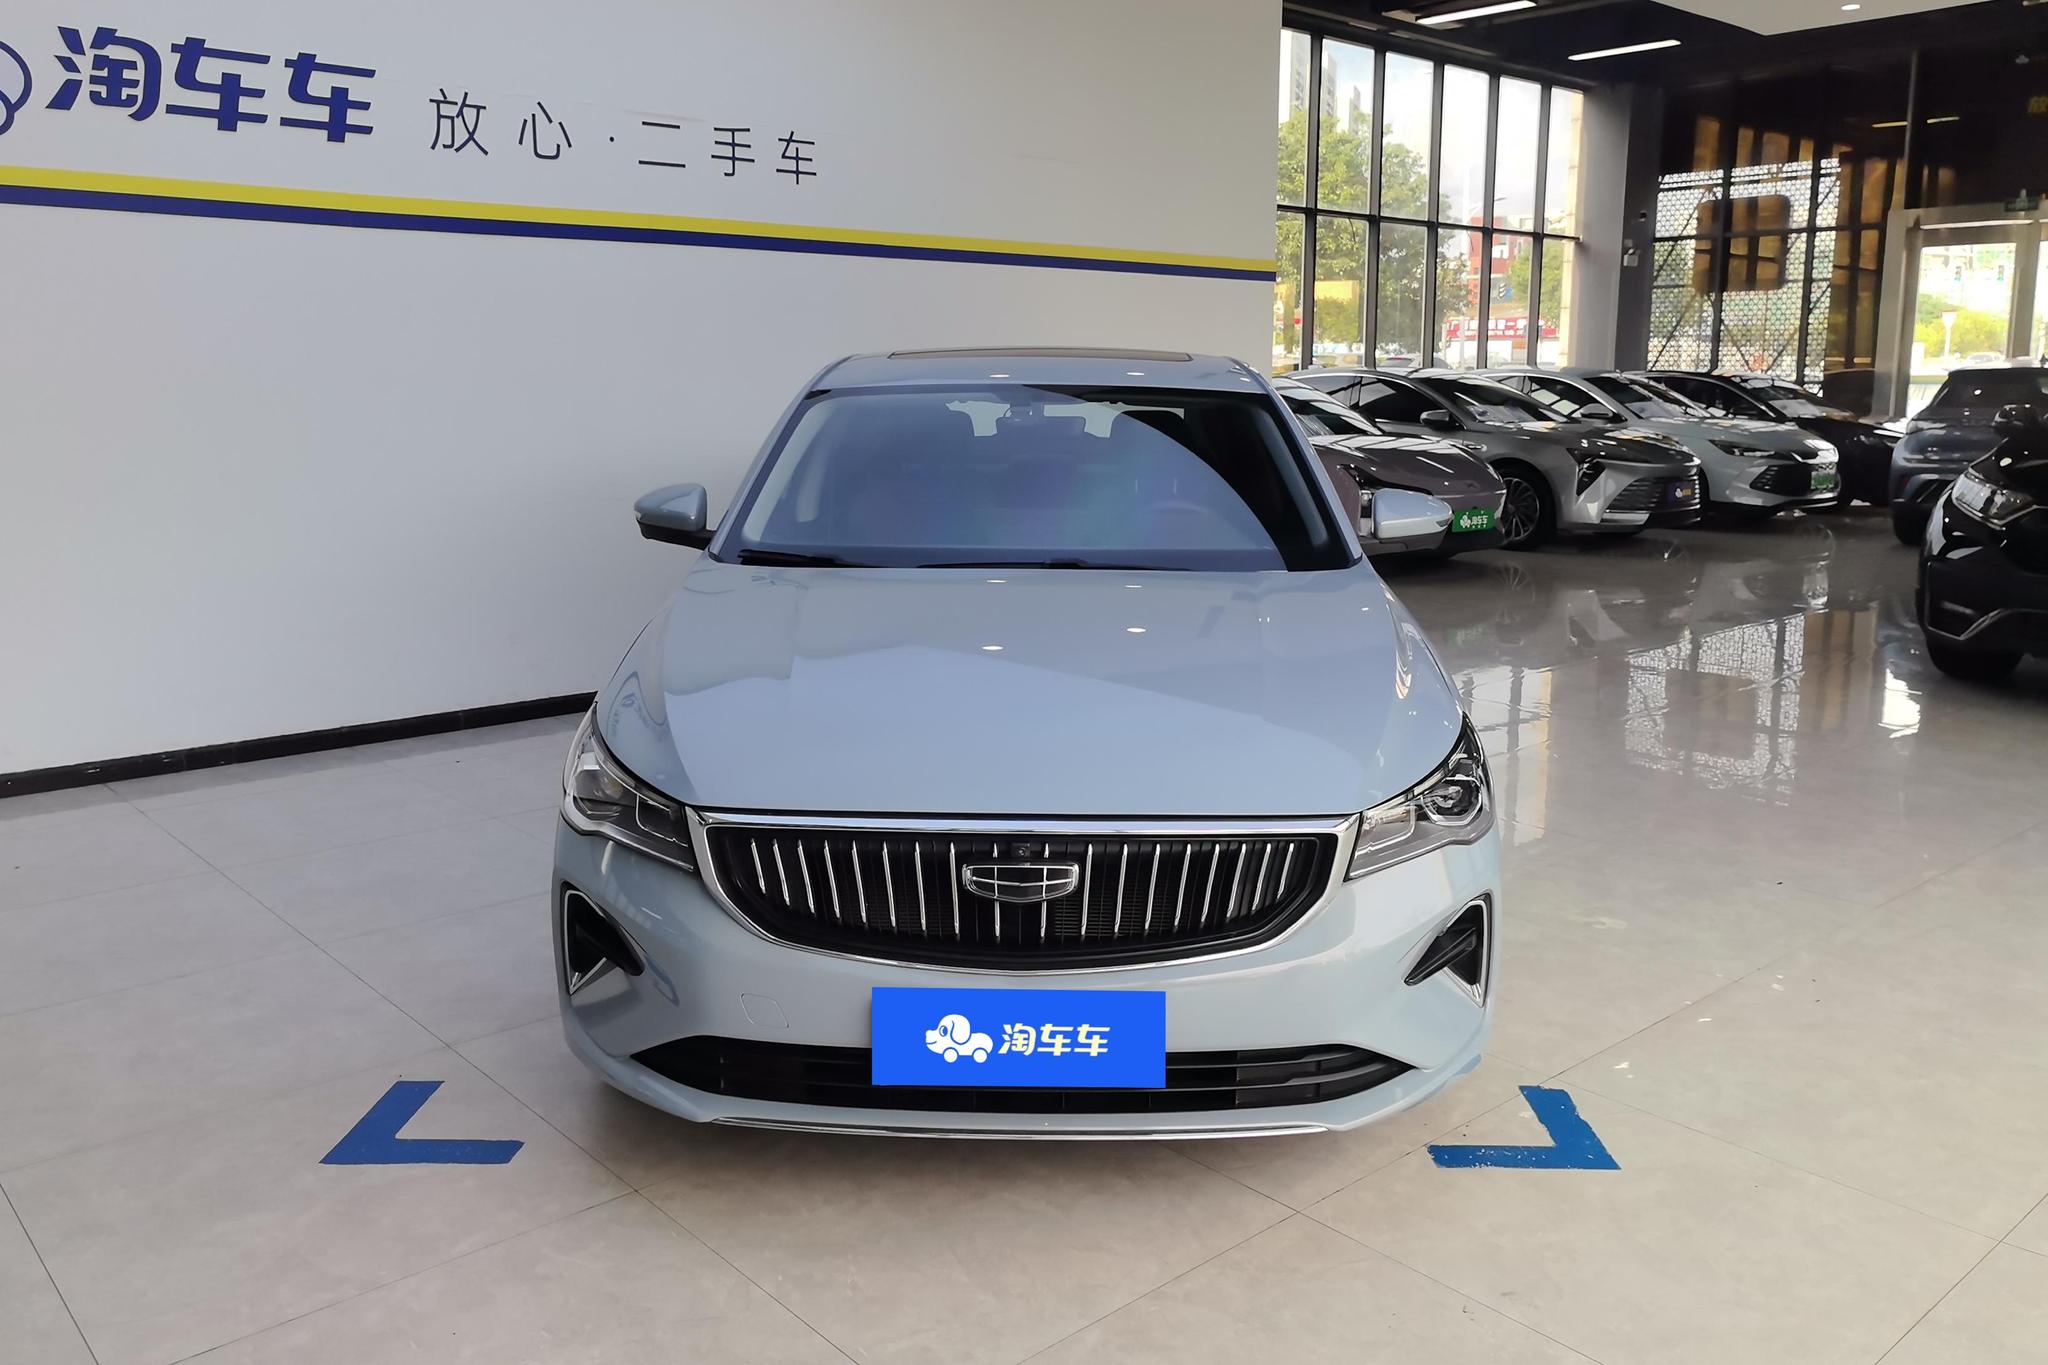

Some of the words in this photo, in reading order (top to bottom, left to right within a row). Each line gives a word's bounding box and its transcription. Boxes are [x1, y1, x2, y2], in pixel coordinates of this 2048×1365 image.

[45, 26, 377, 143] 淘车车
[998, 1023, 1110, 1056] 淘车车
